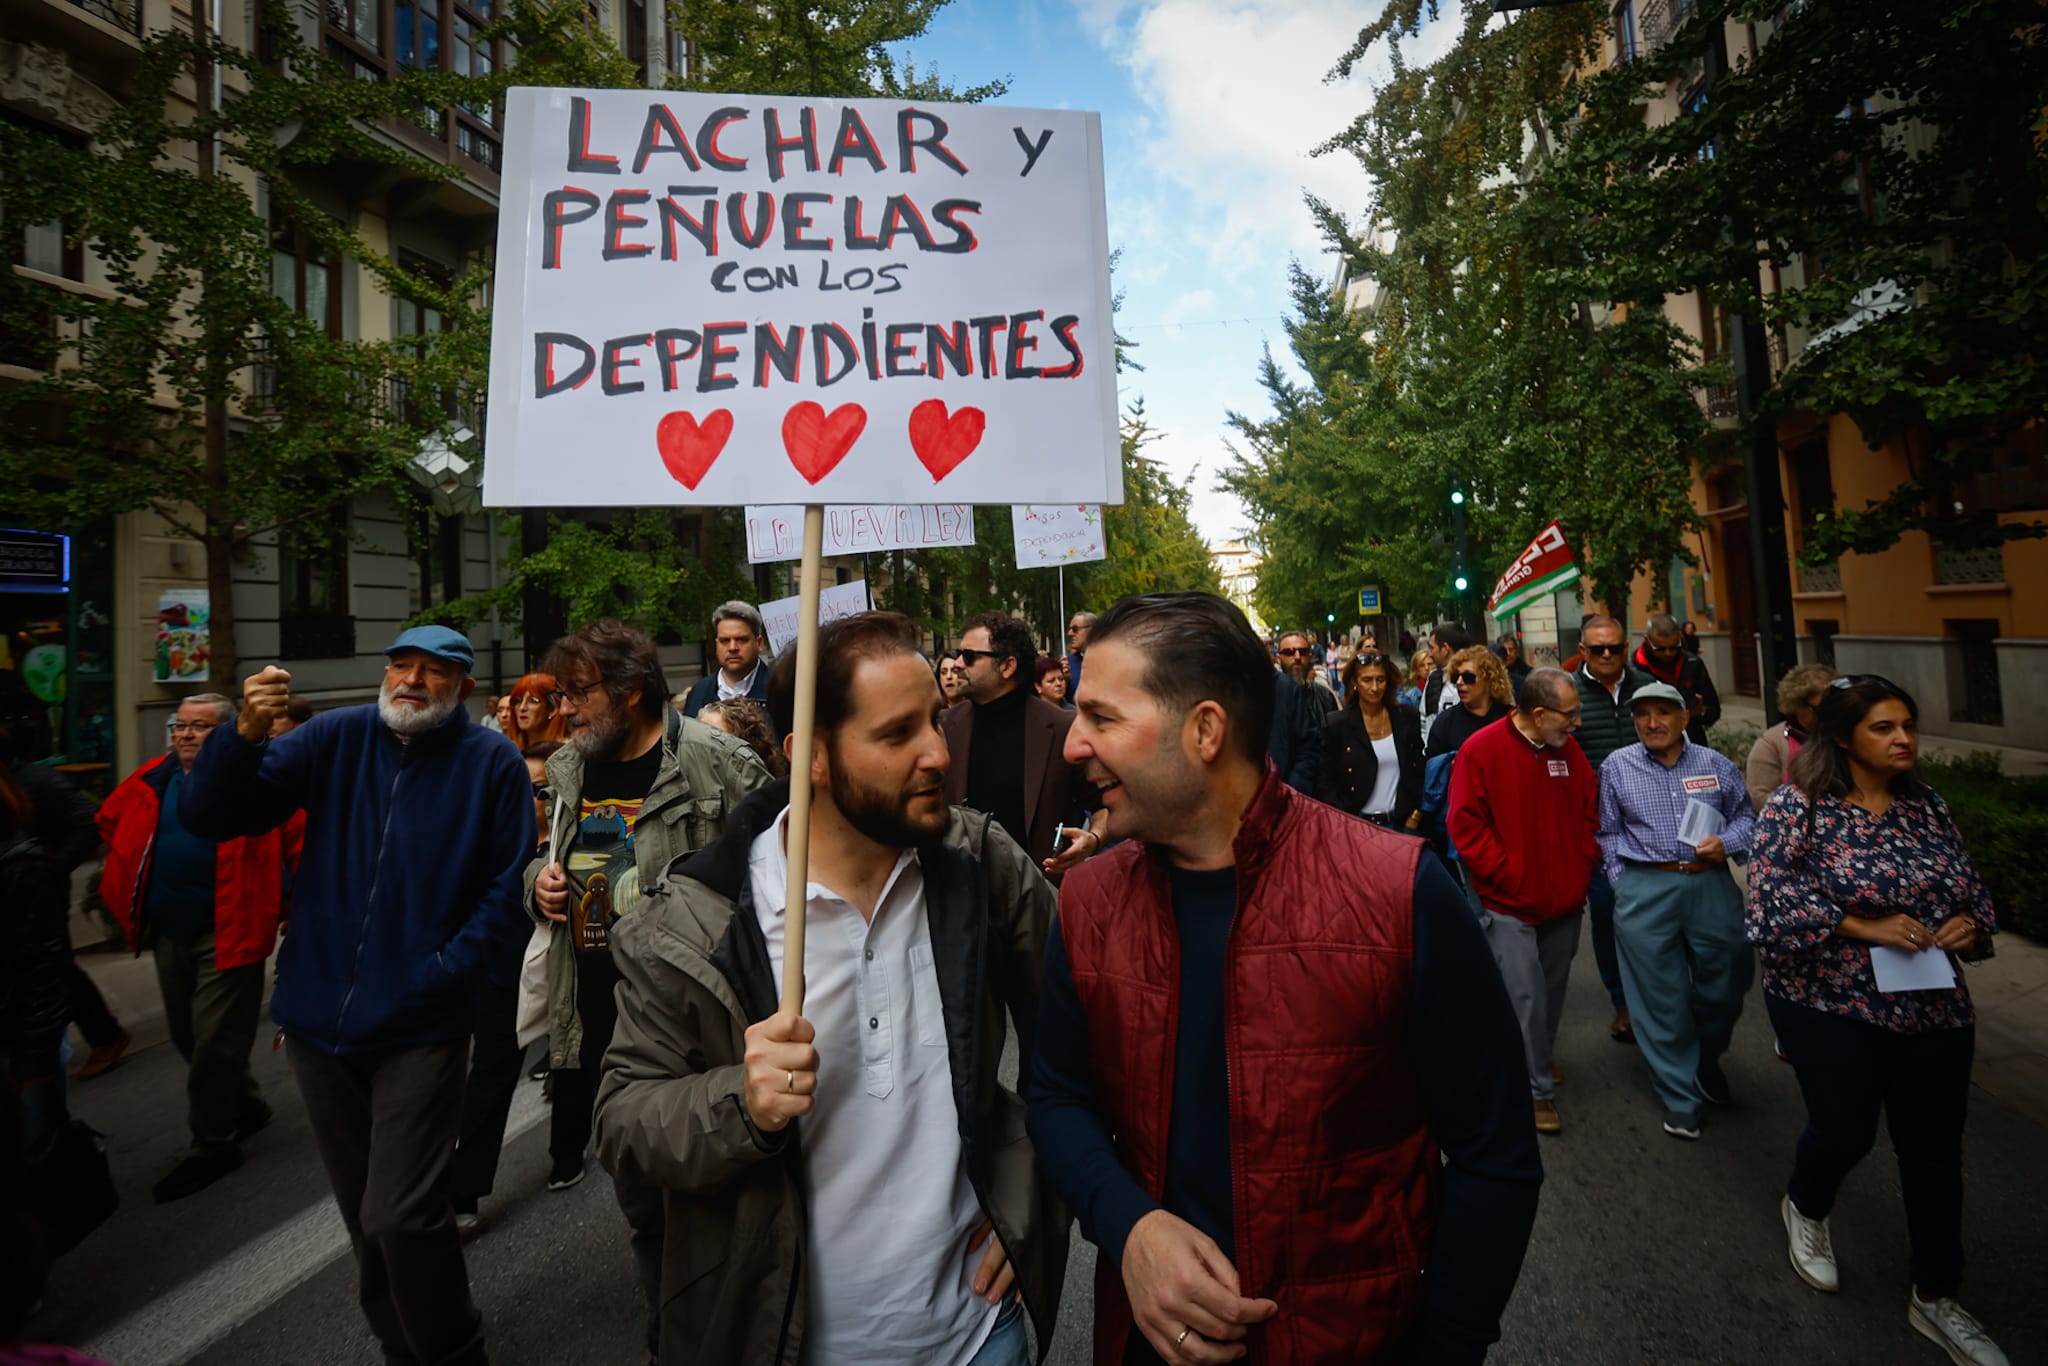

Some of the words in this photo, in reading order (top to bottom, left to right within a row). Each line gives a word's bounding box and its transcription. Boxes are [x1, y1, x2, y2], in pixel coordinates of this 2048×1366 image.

[567, 96, 969, 183] LACHAR
[542, 185, 982, 269] PEÑUELAS
[710, 261, 799, 292] CON
[818, 259, 909, 294] LOS
[749, 518, 794, 559] LA
[920, 504, 970, 544] LEY
